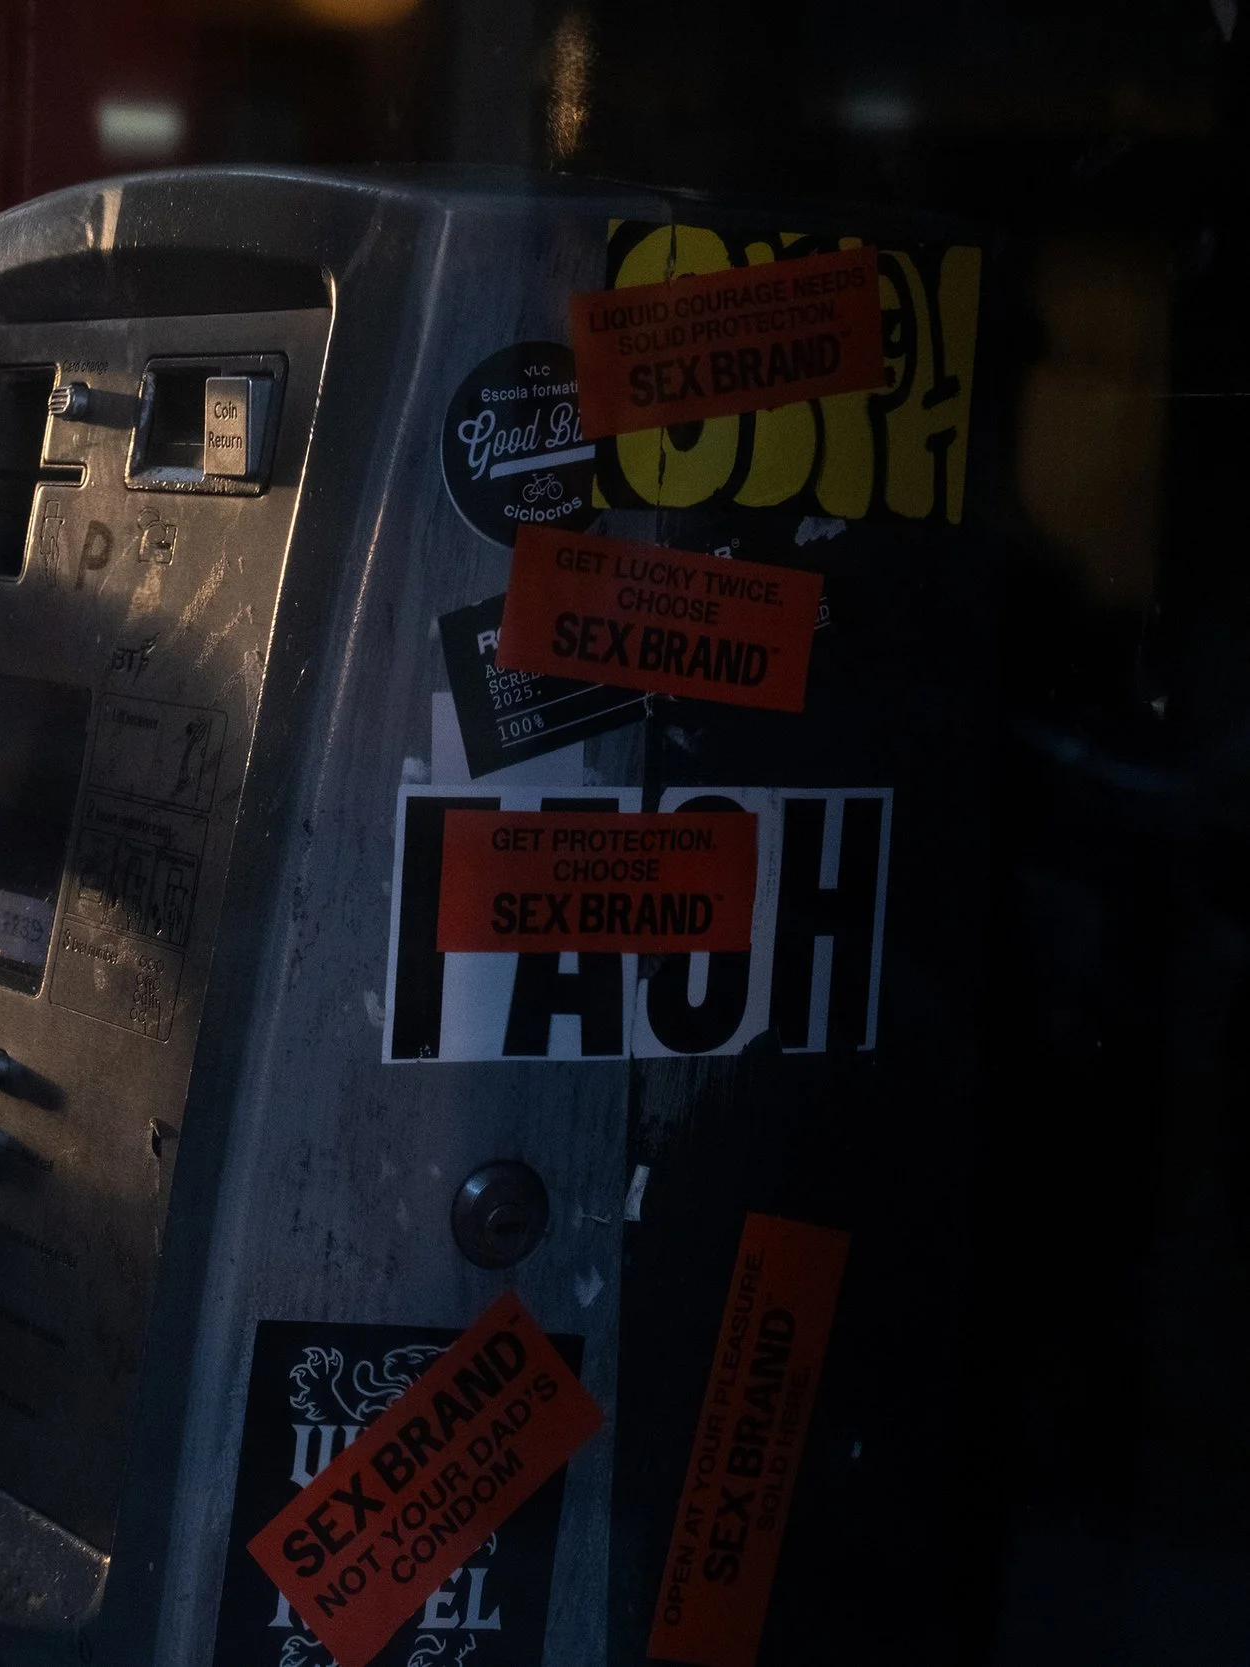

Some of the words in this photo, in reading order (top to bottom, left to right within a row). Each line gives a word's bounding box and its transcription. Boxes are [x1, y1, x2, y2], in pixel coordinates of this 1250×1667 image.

[588, 304, 669, 333] LIQUID
[675, 280, 788, 318] COURAGE
[790, 266, 866, 298] NEEDS
[619, 328, 685, 355] SOLID
[481, 386, 528, 402] Escola
[532, 380, 579, 397] formati
[524, 365, 551, 377] VLC
[629, 355, 705, 407] SEX
[214, 401, 238, 420] Coin
[208, 430, 243, 449] Return
[457, 408, 541, 481] Good
[545, 402, 583, 448] Bi
[556, 548, 608, 576] GET
[613, 556, 698, 590] LUCKY
[618, 586, 722, 625] CHOOSE
[552, 611, 634, 668] SEX
[498, 714, 544, 742] 100%
[492, 828, 545, 851] GET
[552, 828, 717, 851] PROTECTION.
[553, 859, 660, 882] CHOOSE
[491, 892, 572, 935] SEX
[692, 1415, 727, 1494] YOUR
[314, 1544, 381, 1619] NOT
[382, 1461, 470, 1547] YOUR
[468, 1372, 559, 1468] DAD'S
[758, 1455, 789, 1532] SOLD
[282, 1473, 387, 1578] SEX
[391, 1448, 524, 1584] CONDOM
[684, 1502, 705, 1539] AT
[702, 1484, 756, 1586] SEX
[664, 1544, 695, 1626] OPEN
